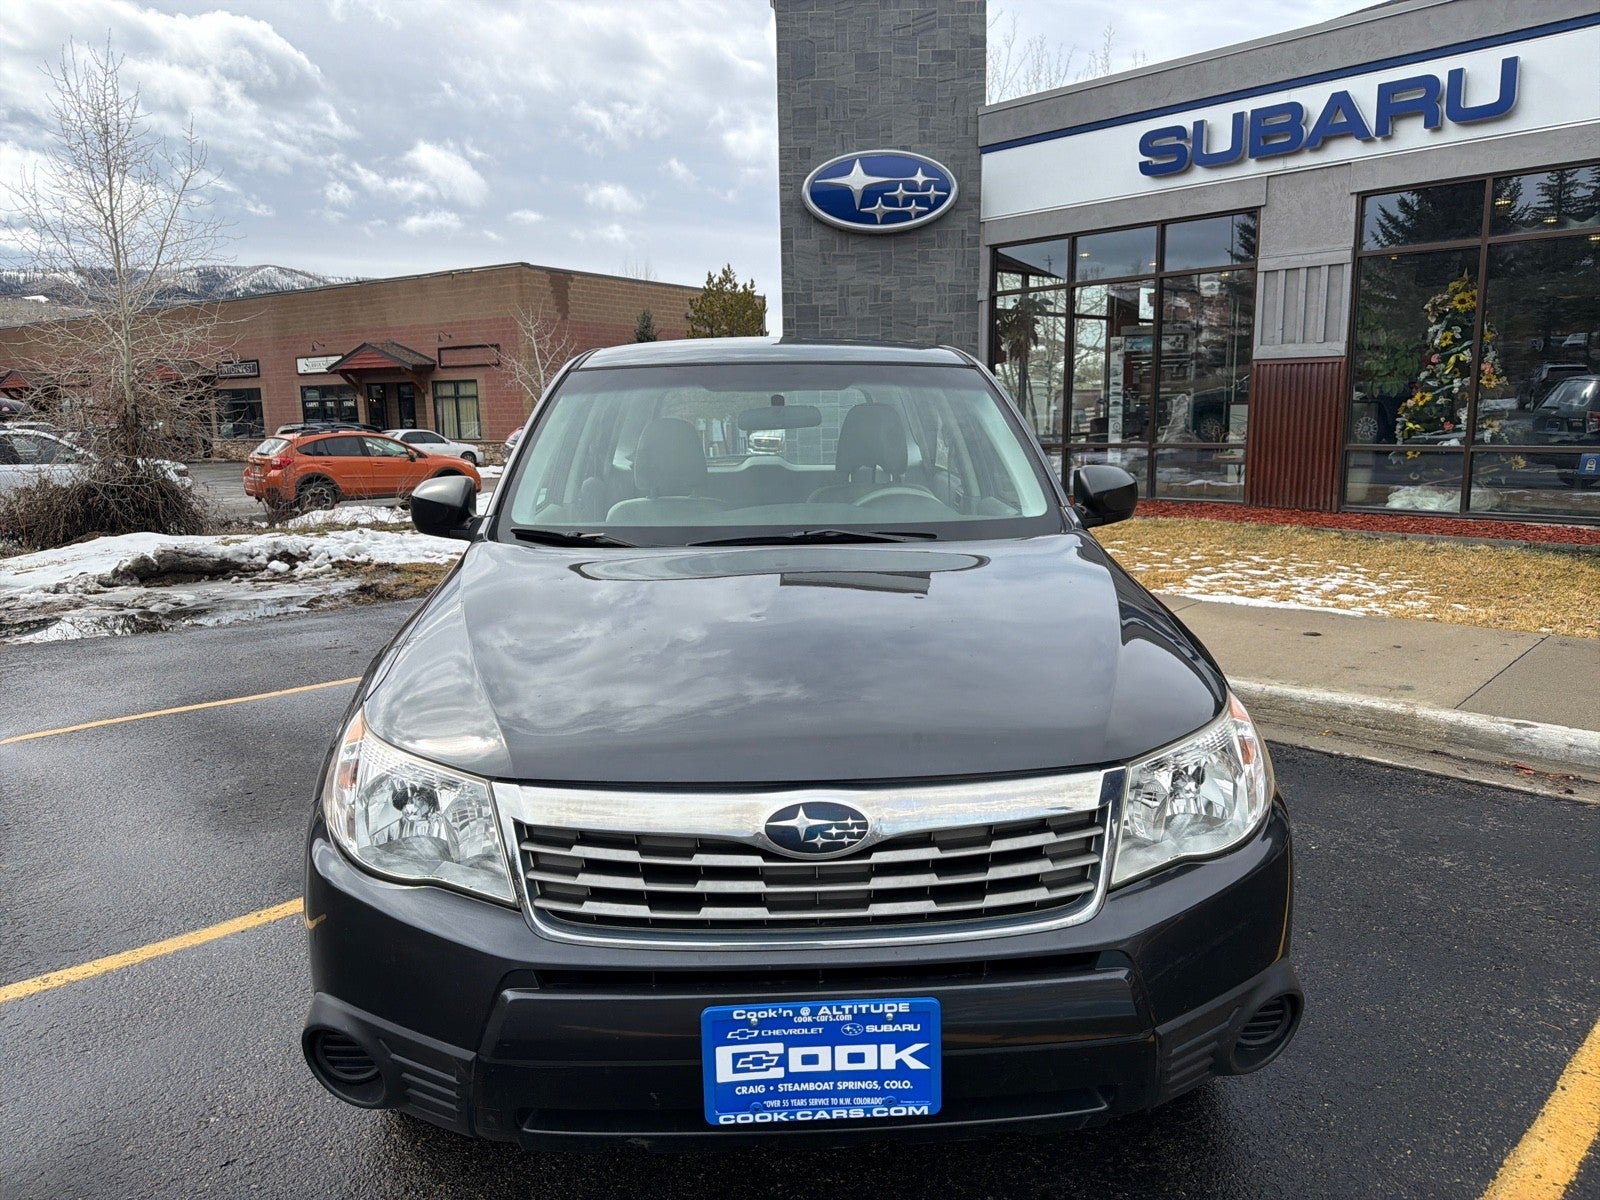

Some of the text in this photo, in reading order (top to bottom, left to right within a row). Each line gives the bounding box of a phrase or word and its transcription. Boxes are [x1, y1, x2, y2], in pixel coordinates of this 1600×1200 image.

[1138, 56, 1521, 177] SUBARU
[732, 1003, 910, 1020] Cook'n @ ALTITUDE
[793, 1013, 852, 1023] cook-cars.com
[761, 1027, 824, 1037] CHEVROLET
[865, 1023, 921, 1033] SUBARU
[715, 1042, 931, 1084] COOK
[735, 1080, 913, 1095] CRAIG STEAMBOAT SPRINGS, COLO.
[782, 1099, 790, 1107] 55
[790, 1098, 808, 1107] YEARS
[808, 1098, 829, 1107] SERVICE
[831, 1097, 838, 1106] TO
[839, 1097, 852, 1106] N.W.
[718, 1105, 929, 1125] COOK-CARS.COM
